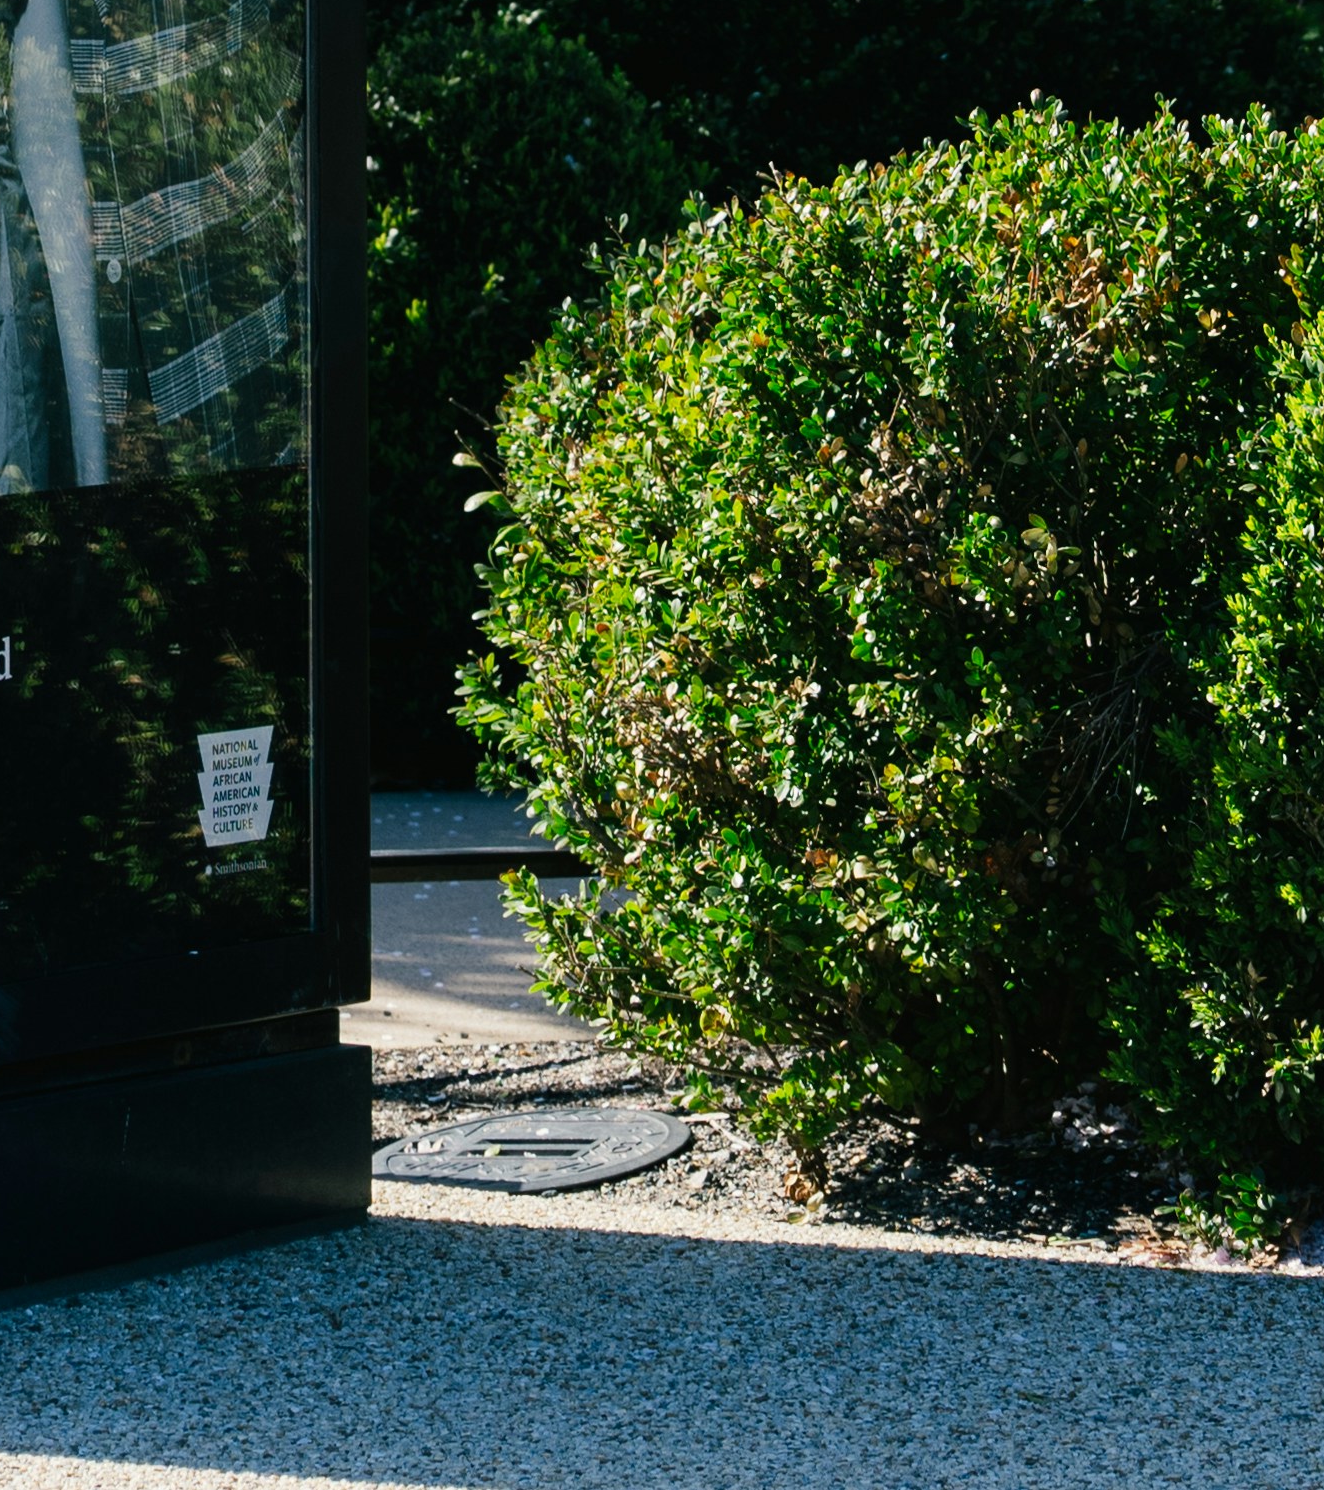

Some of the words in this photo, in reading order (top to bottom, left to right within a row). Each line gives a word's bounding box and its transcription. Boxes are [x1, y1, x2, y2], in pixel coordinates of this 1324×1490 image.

[212, 739, 259, 756] NATIONAL
[212, 755, 253, 772] MUSEUM
[253, 753, 261, 767] of
[212, 771, 252, 787] AFRICAN
[212, 785, 260, 803] AMERICAN
[212, 802, 252, 819] HISTORY
[252, 802, 259, 813] &
[212, 818, 254, 834] CULTURE
[214, 858, 268, 875] Smithsonian
